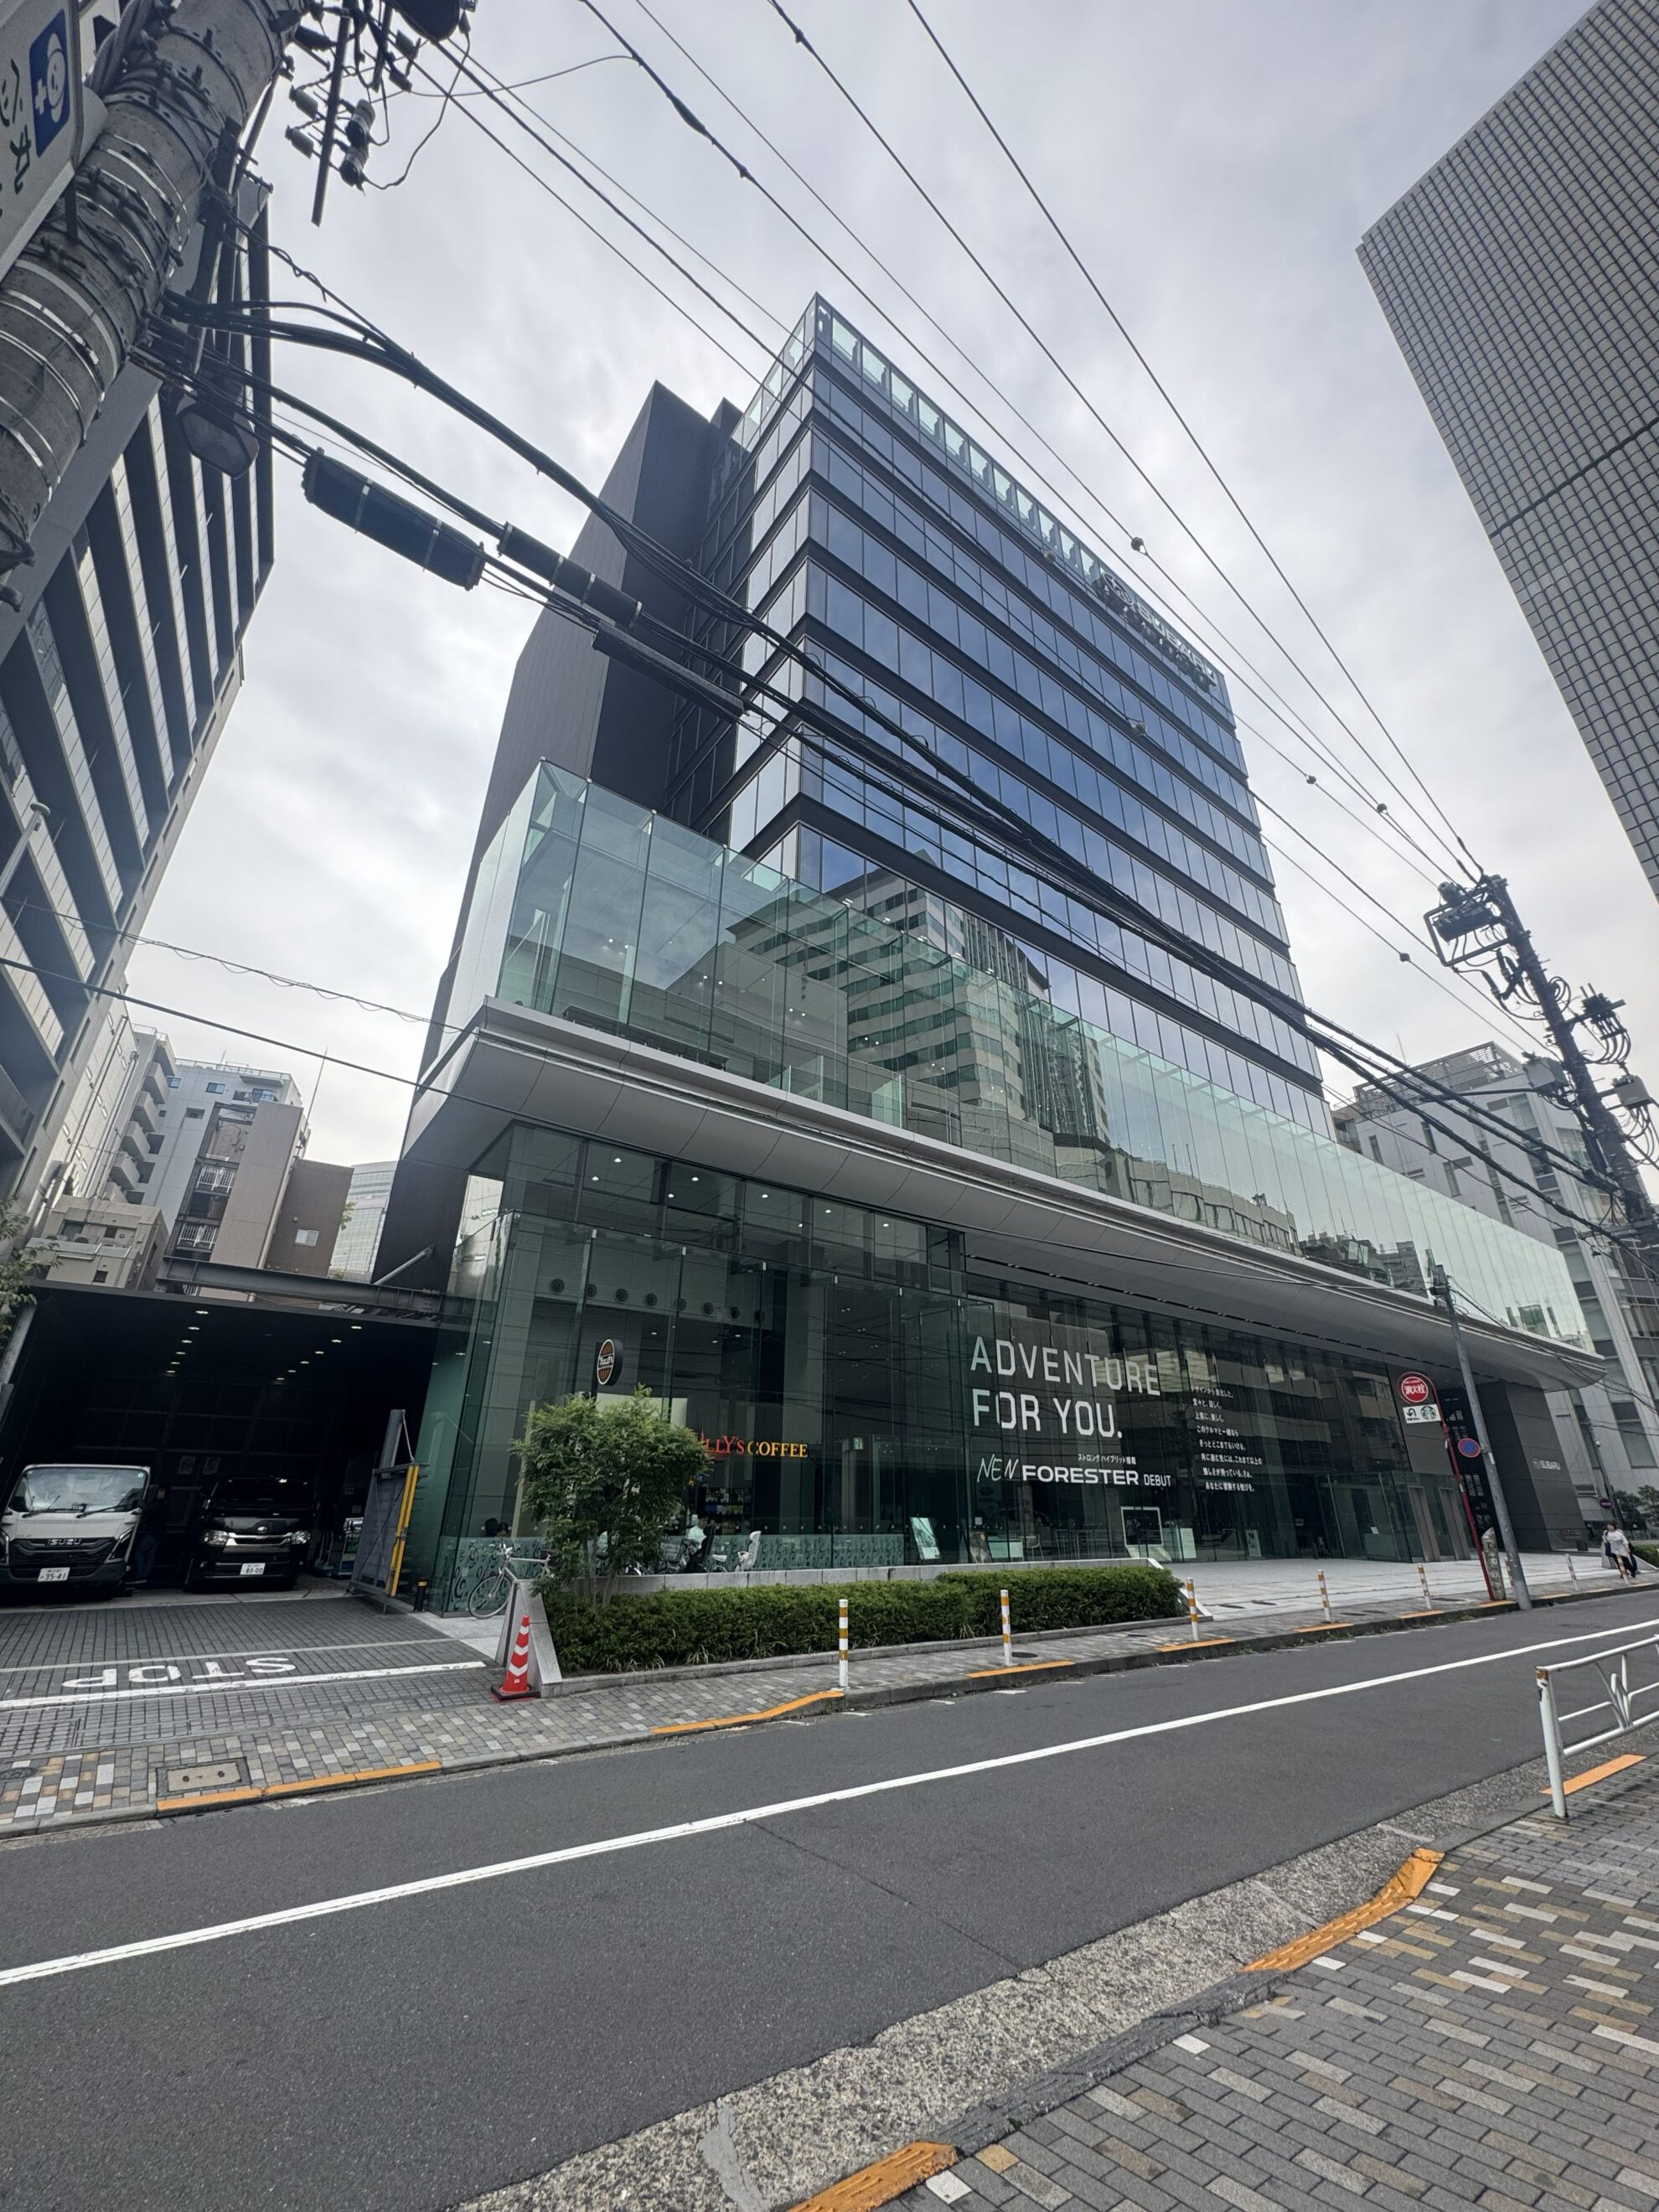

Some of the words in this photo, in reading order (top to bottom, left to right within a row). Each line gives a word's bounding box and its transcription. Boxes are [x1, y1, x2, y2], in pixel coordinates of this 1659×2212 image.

[1137, 602, 1218, 687] SUBARU
[970, 1336, 1160, 1396] ADVENTURE
[1403, 1382, 1426, 1396] 消火栓
[972, 1388, 1041, 1432] FOR
[1052, 1398, 1123, 1439] YOU.
[747, 1440, 809, 1458] COFFEE
[1022, 1465, 1140, 1486] FORESTER
[1143, 1474, 1171, 1487] DEBUT
[61, 1657, 296, 1687] STOP
